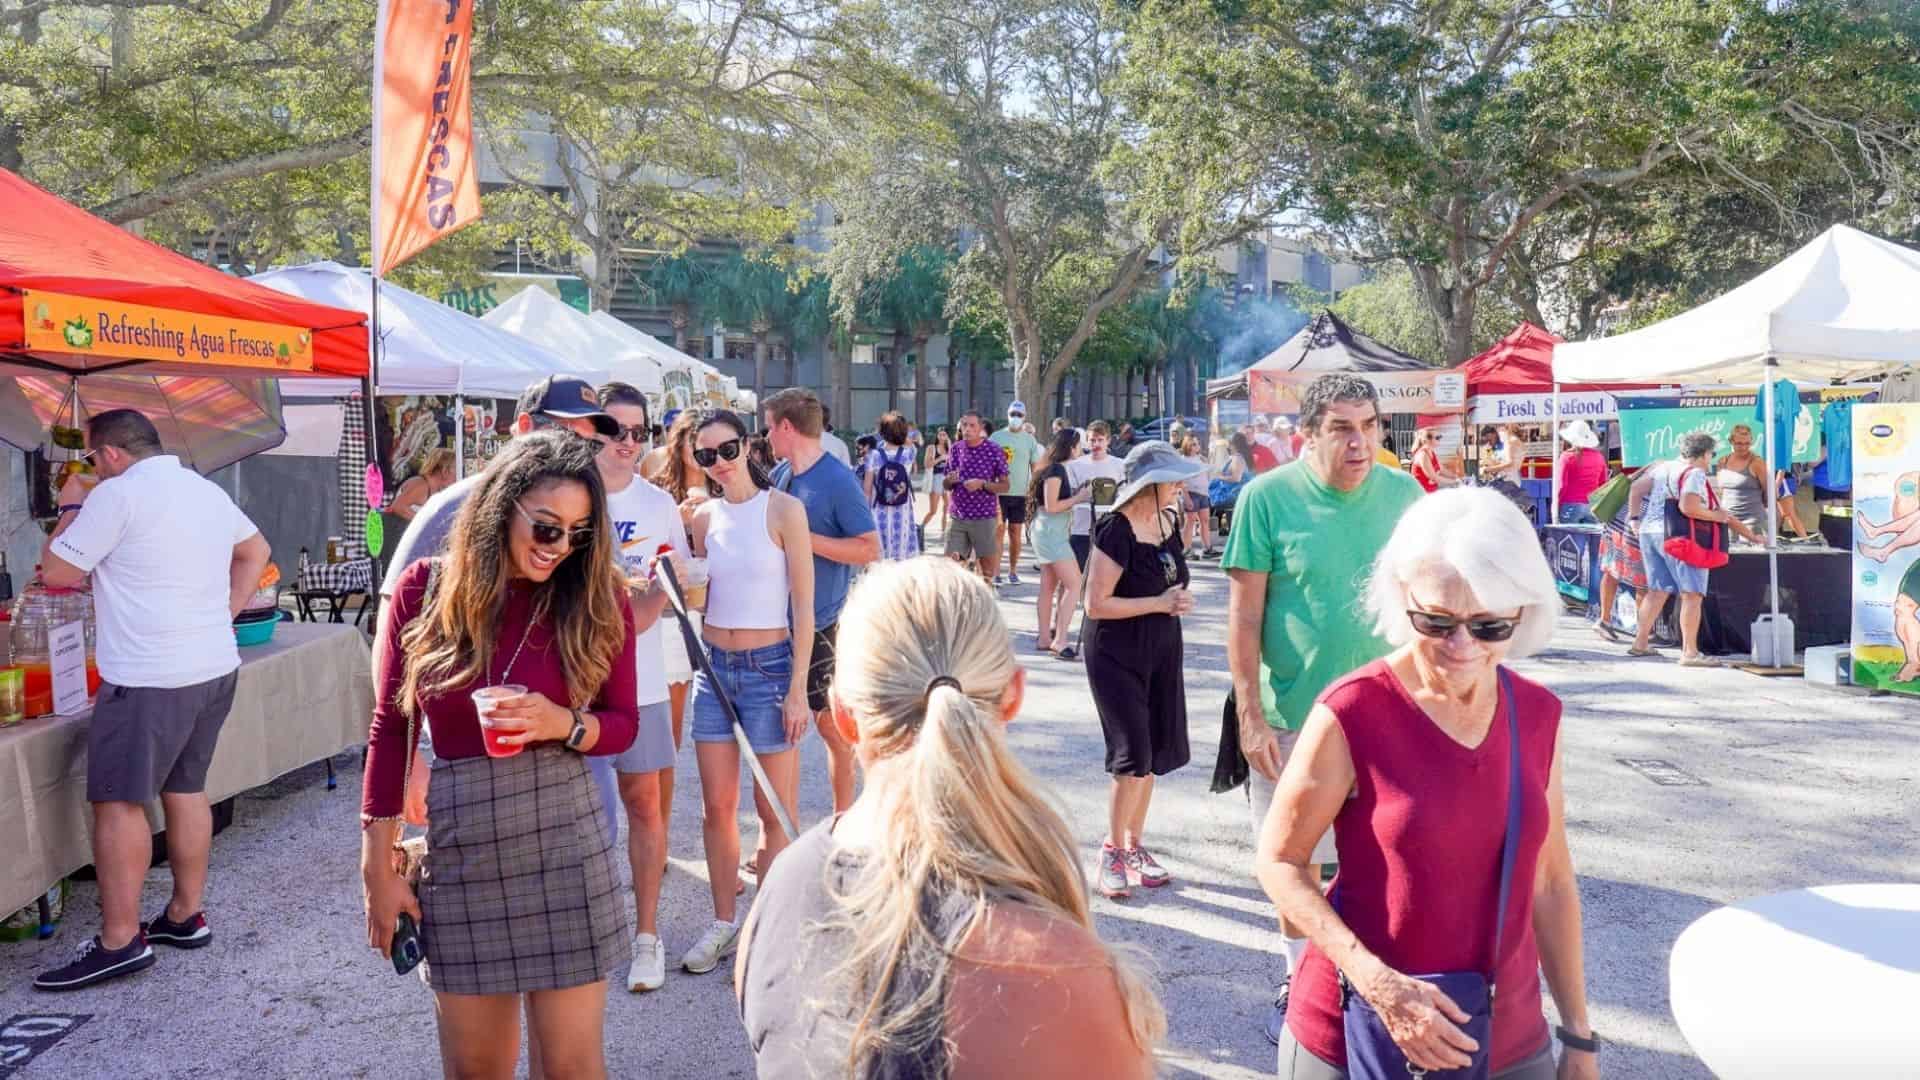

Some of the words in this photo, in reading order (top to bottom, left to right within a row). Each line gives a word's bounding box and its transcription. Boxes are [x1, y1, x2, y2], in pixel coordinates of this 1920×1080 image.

[97, 312, 185, 358] Refreshing
[189, 324, 225, 358] Agua
[229, 328, 275, 358] Frescas
[1378, 383, 1433, 398] USAGES
[1497, 399, 1537, 418] Fresh
[1543, 397, 1604, 416] Safood
